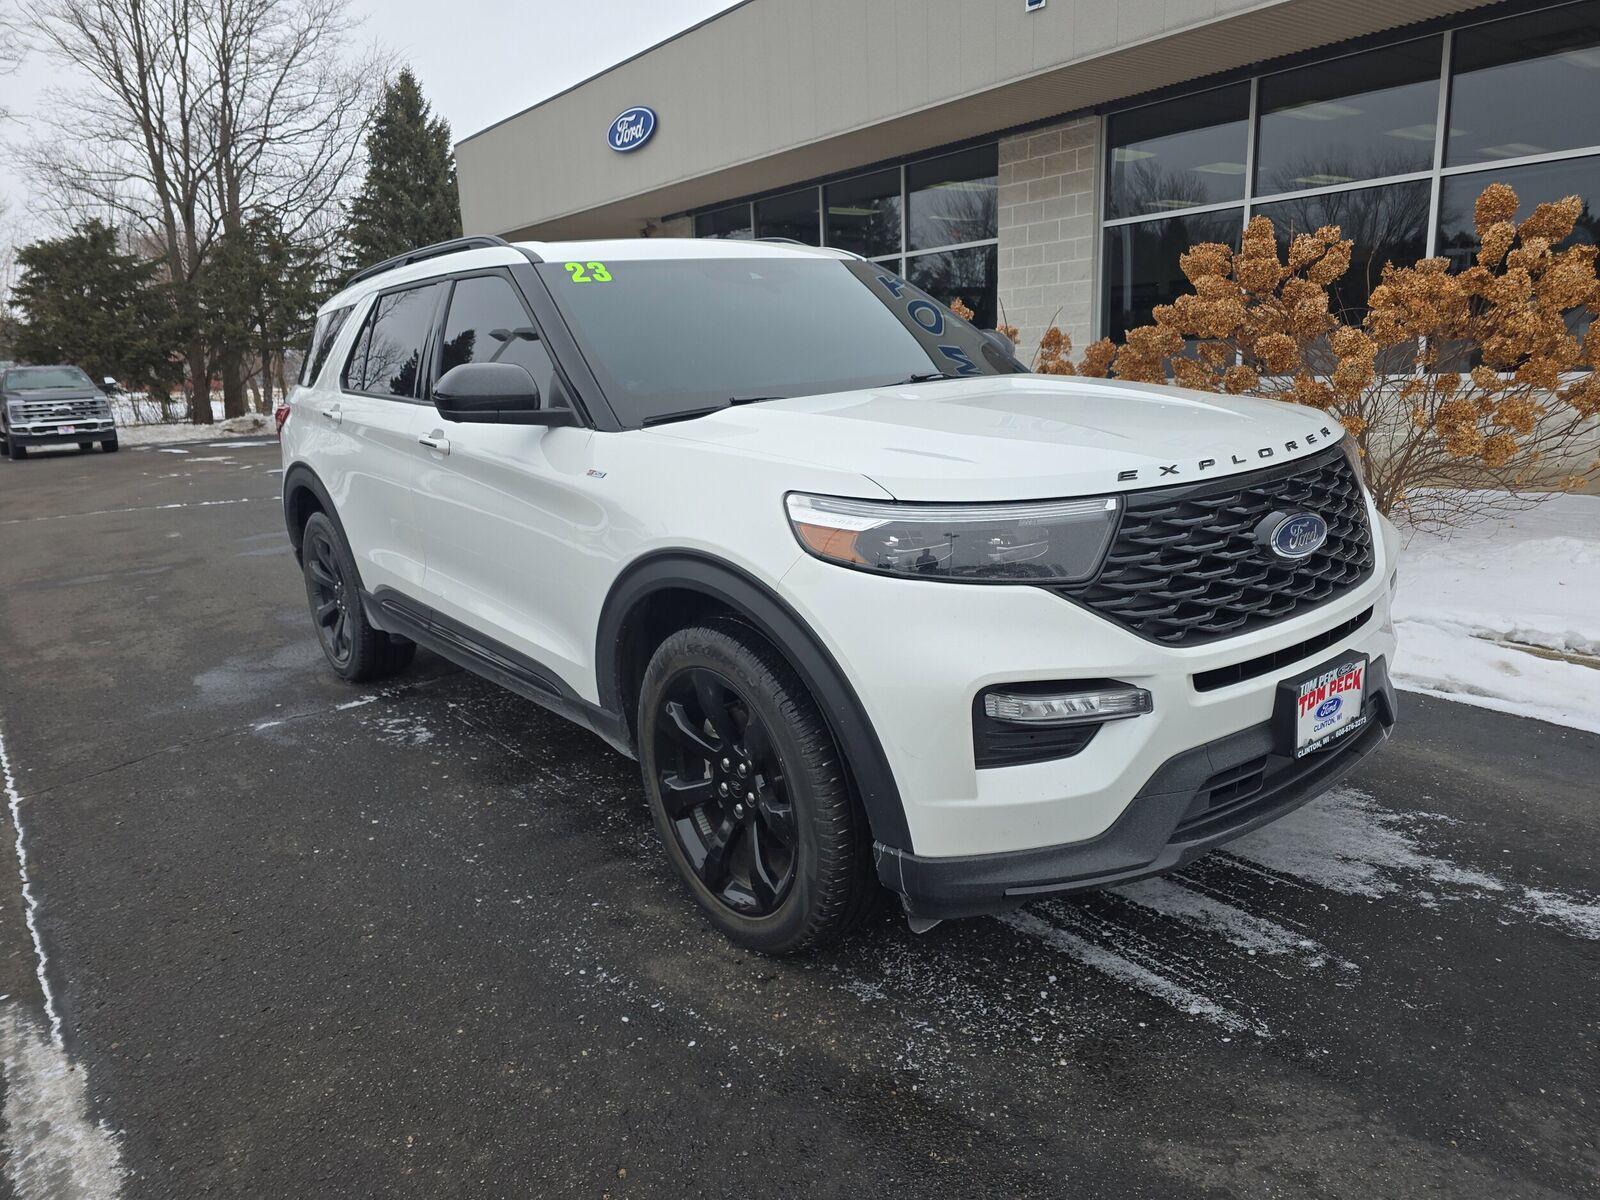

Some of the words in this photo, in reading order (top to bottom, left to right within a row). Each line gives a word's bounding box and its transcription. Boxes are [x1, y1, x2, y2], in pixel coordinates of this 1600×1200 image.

[615, 113, 645, 146] Ford
[564, 261, 612, 283] 23
[1117, 426, 1331, 482] EXPLORER
[1289, 521, 1319, 549] Ford
[1299, 685, 1326, 718] TOM
[1329, 668, 1362, 696] PECK
